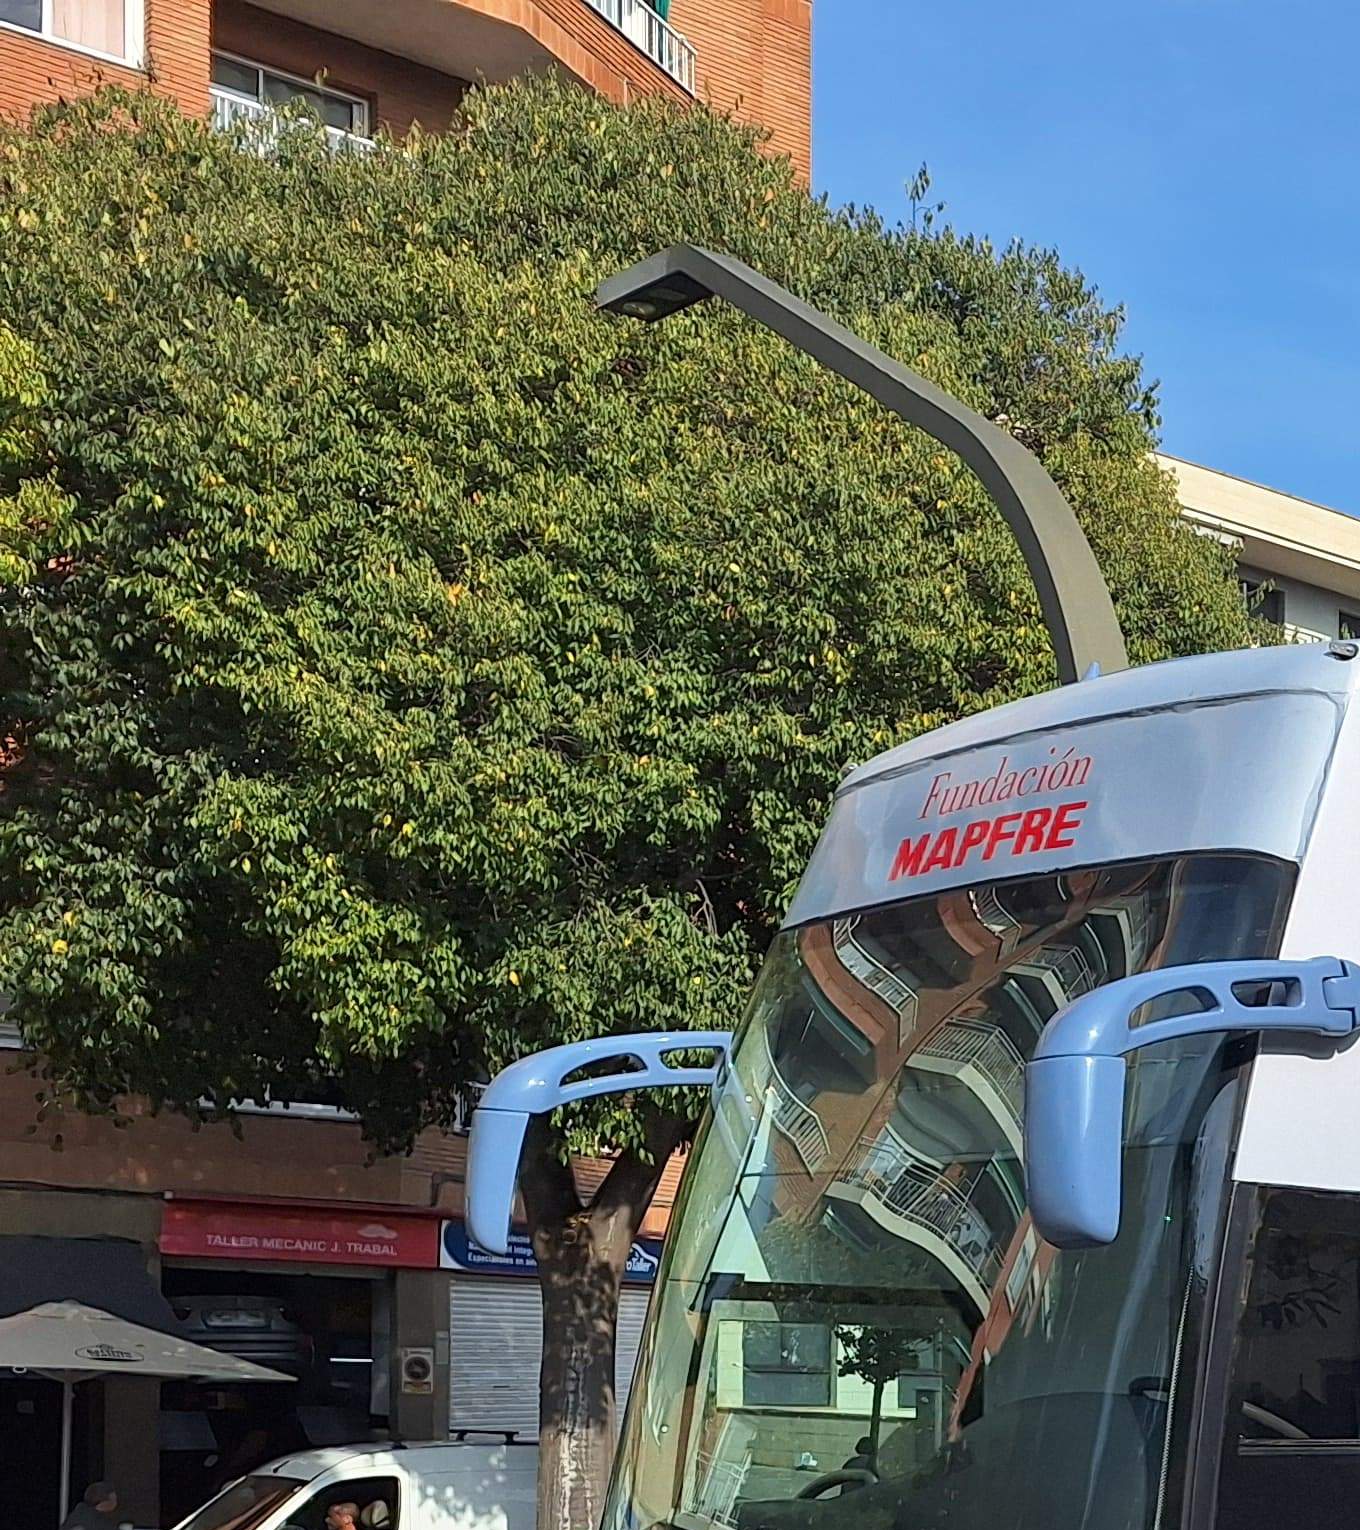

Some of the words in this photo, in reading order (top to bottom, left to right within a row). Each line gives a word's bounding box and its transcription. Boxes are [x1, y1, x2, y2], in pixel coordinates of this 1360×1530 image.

[917, 747, 1092, 820] Fundación
[888, 801, 1088, 881] MAPFRE
[206, 1233, 260, 1249] TALLER
[262, 1236, 327, 1253] MECANIC
[330, 1241, 342, 1254] J.
[346, 1241, 398, 1257] TRABAL
